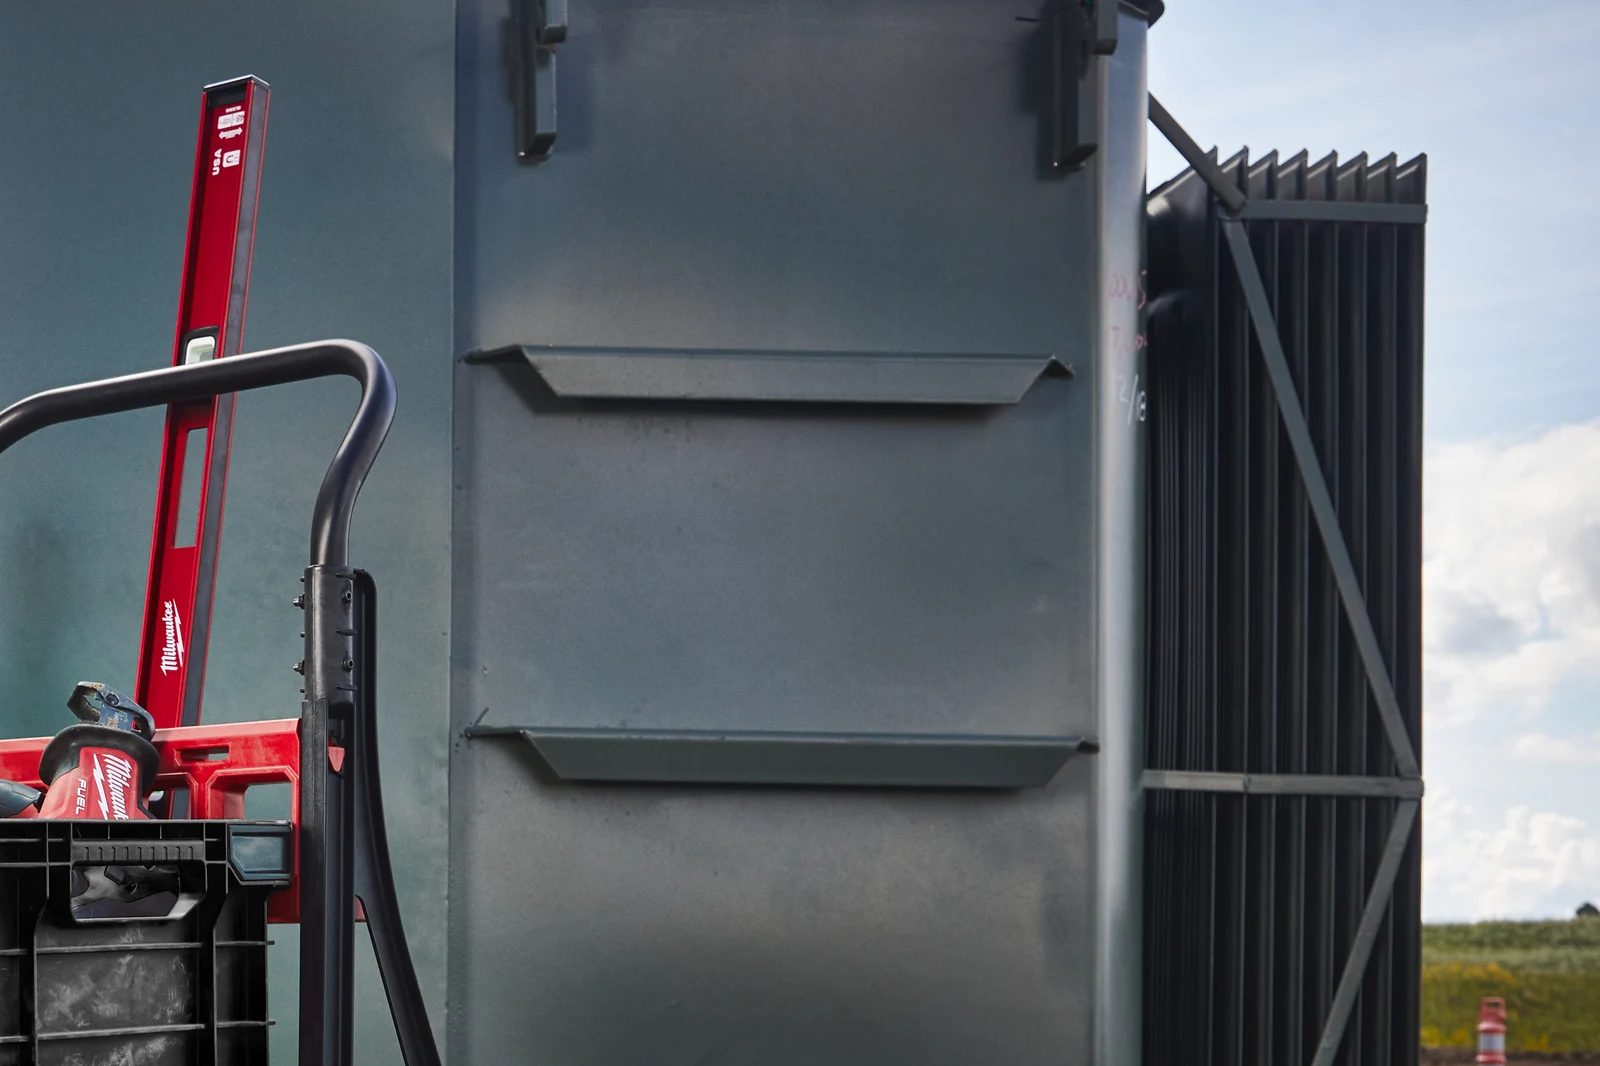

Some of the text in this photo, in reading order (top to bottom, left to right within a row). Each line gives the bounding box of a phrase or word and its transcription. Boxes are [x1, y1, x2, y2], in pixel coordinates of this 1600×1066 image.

[212, 148, 222, 176] USA
[160, 600, 178, 676] Milwaukee
[75, 778, 87, 815] FUEL
